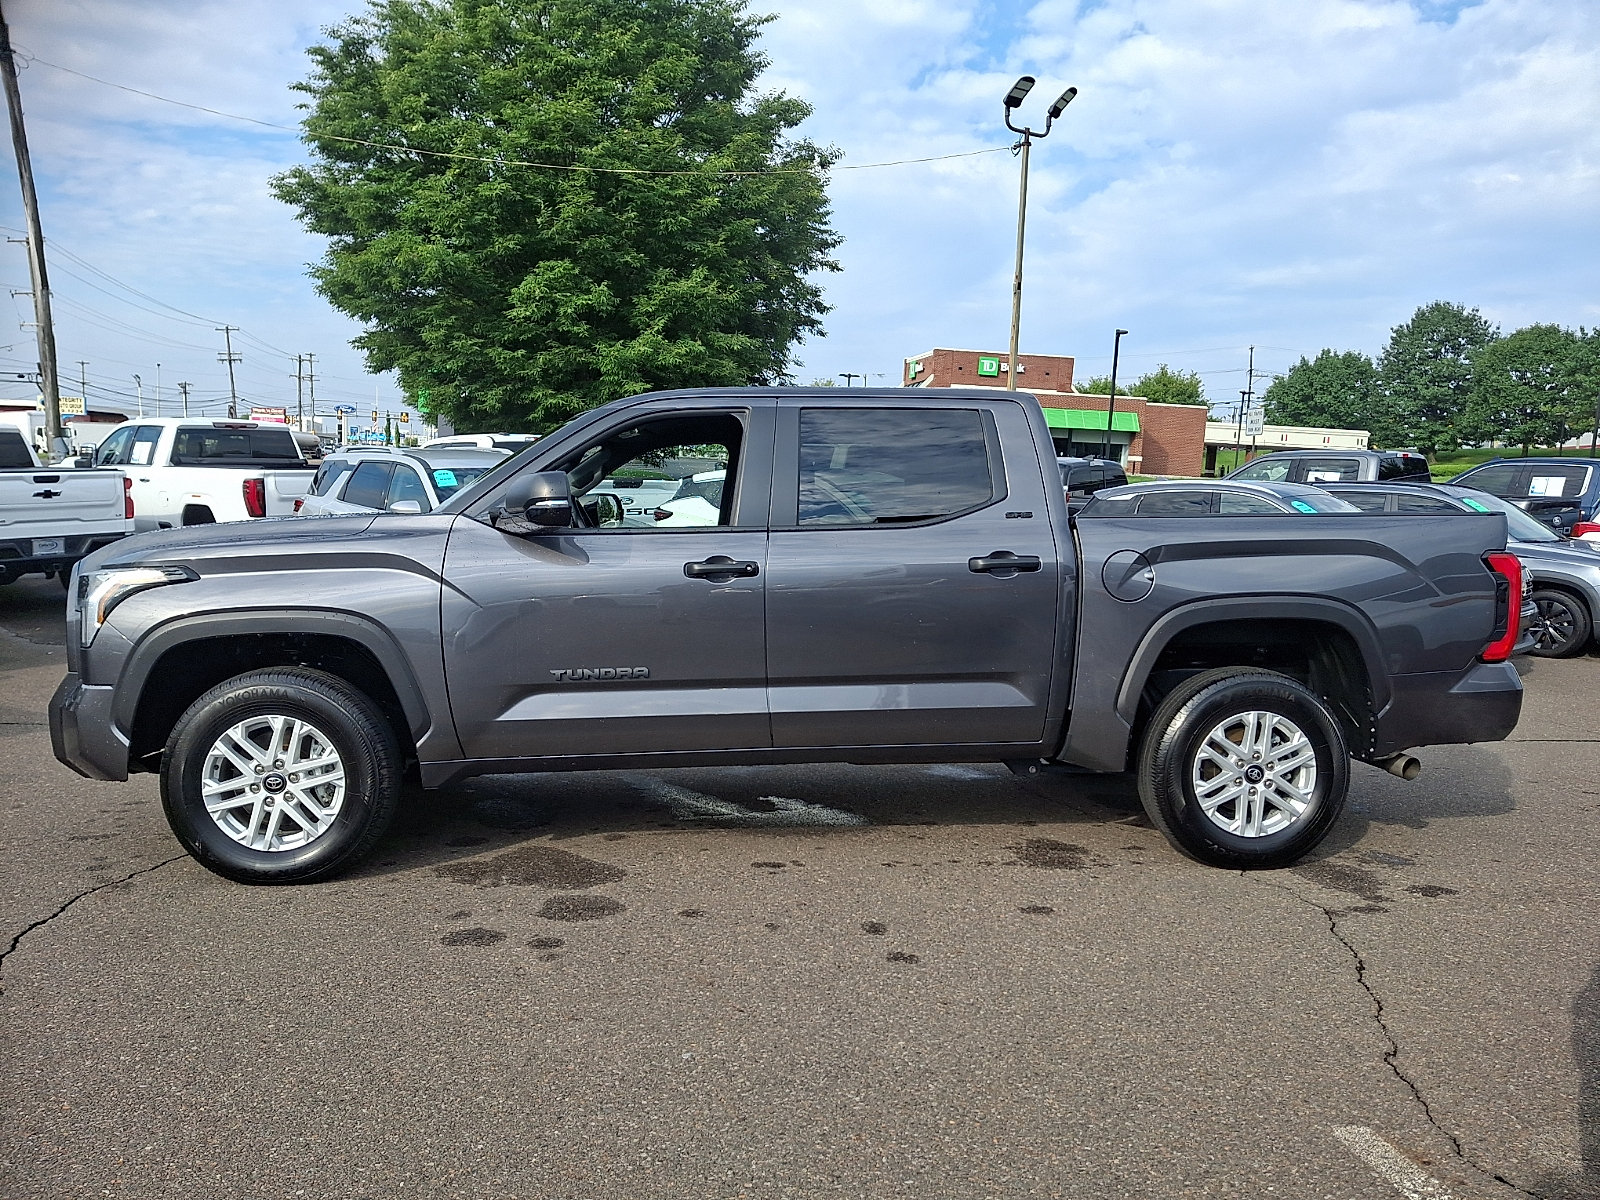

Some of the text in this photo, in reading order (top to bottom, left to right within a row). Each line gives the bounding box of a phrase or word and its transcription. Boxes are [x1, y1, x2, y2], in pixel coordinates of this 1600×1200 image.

[980, 359, 1025, 373] TD Bk
[549, 666, 650, 681] TUNDRA
[217, 687, 289, 706] YOKOHAMA
